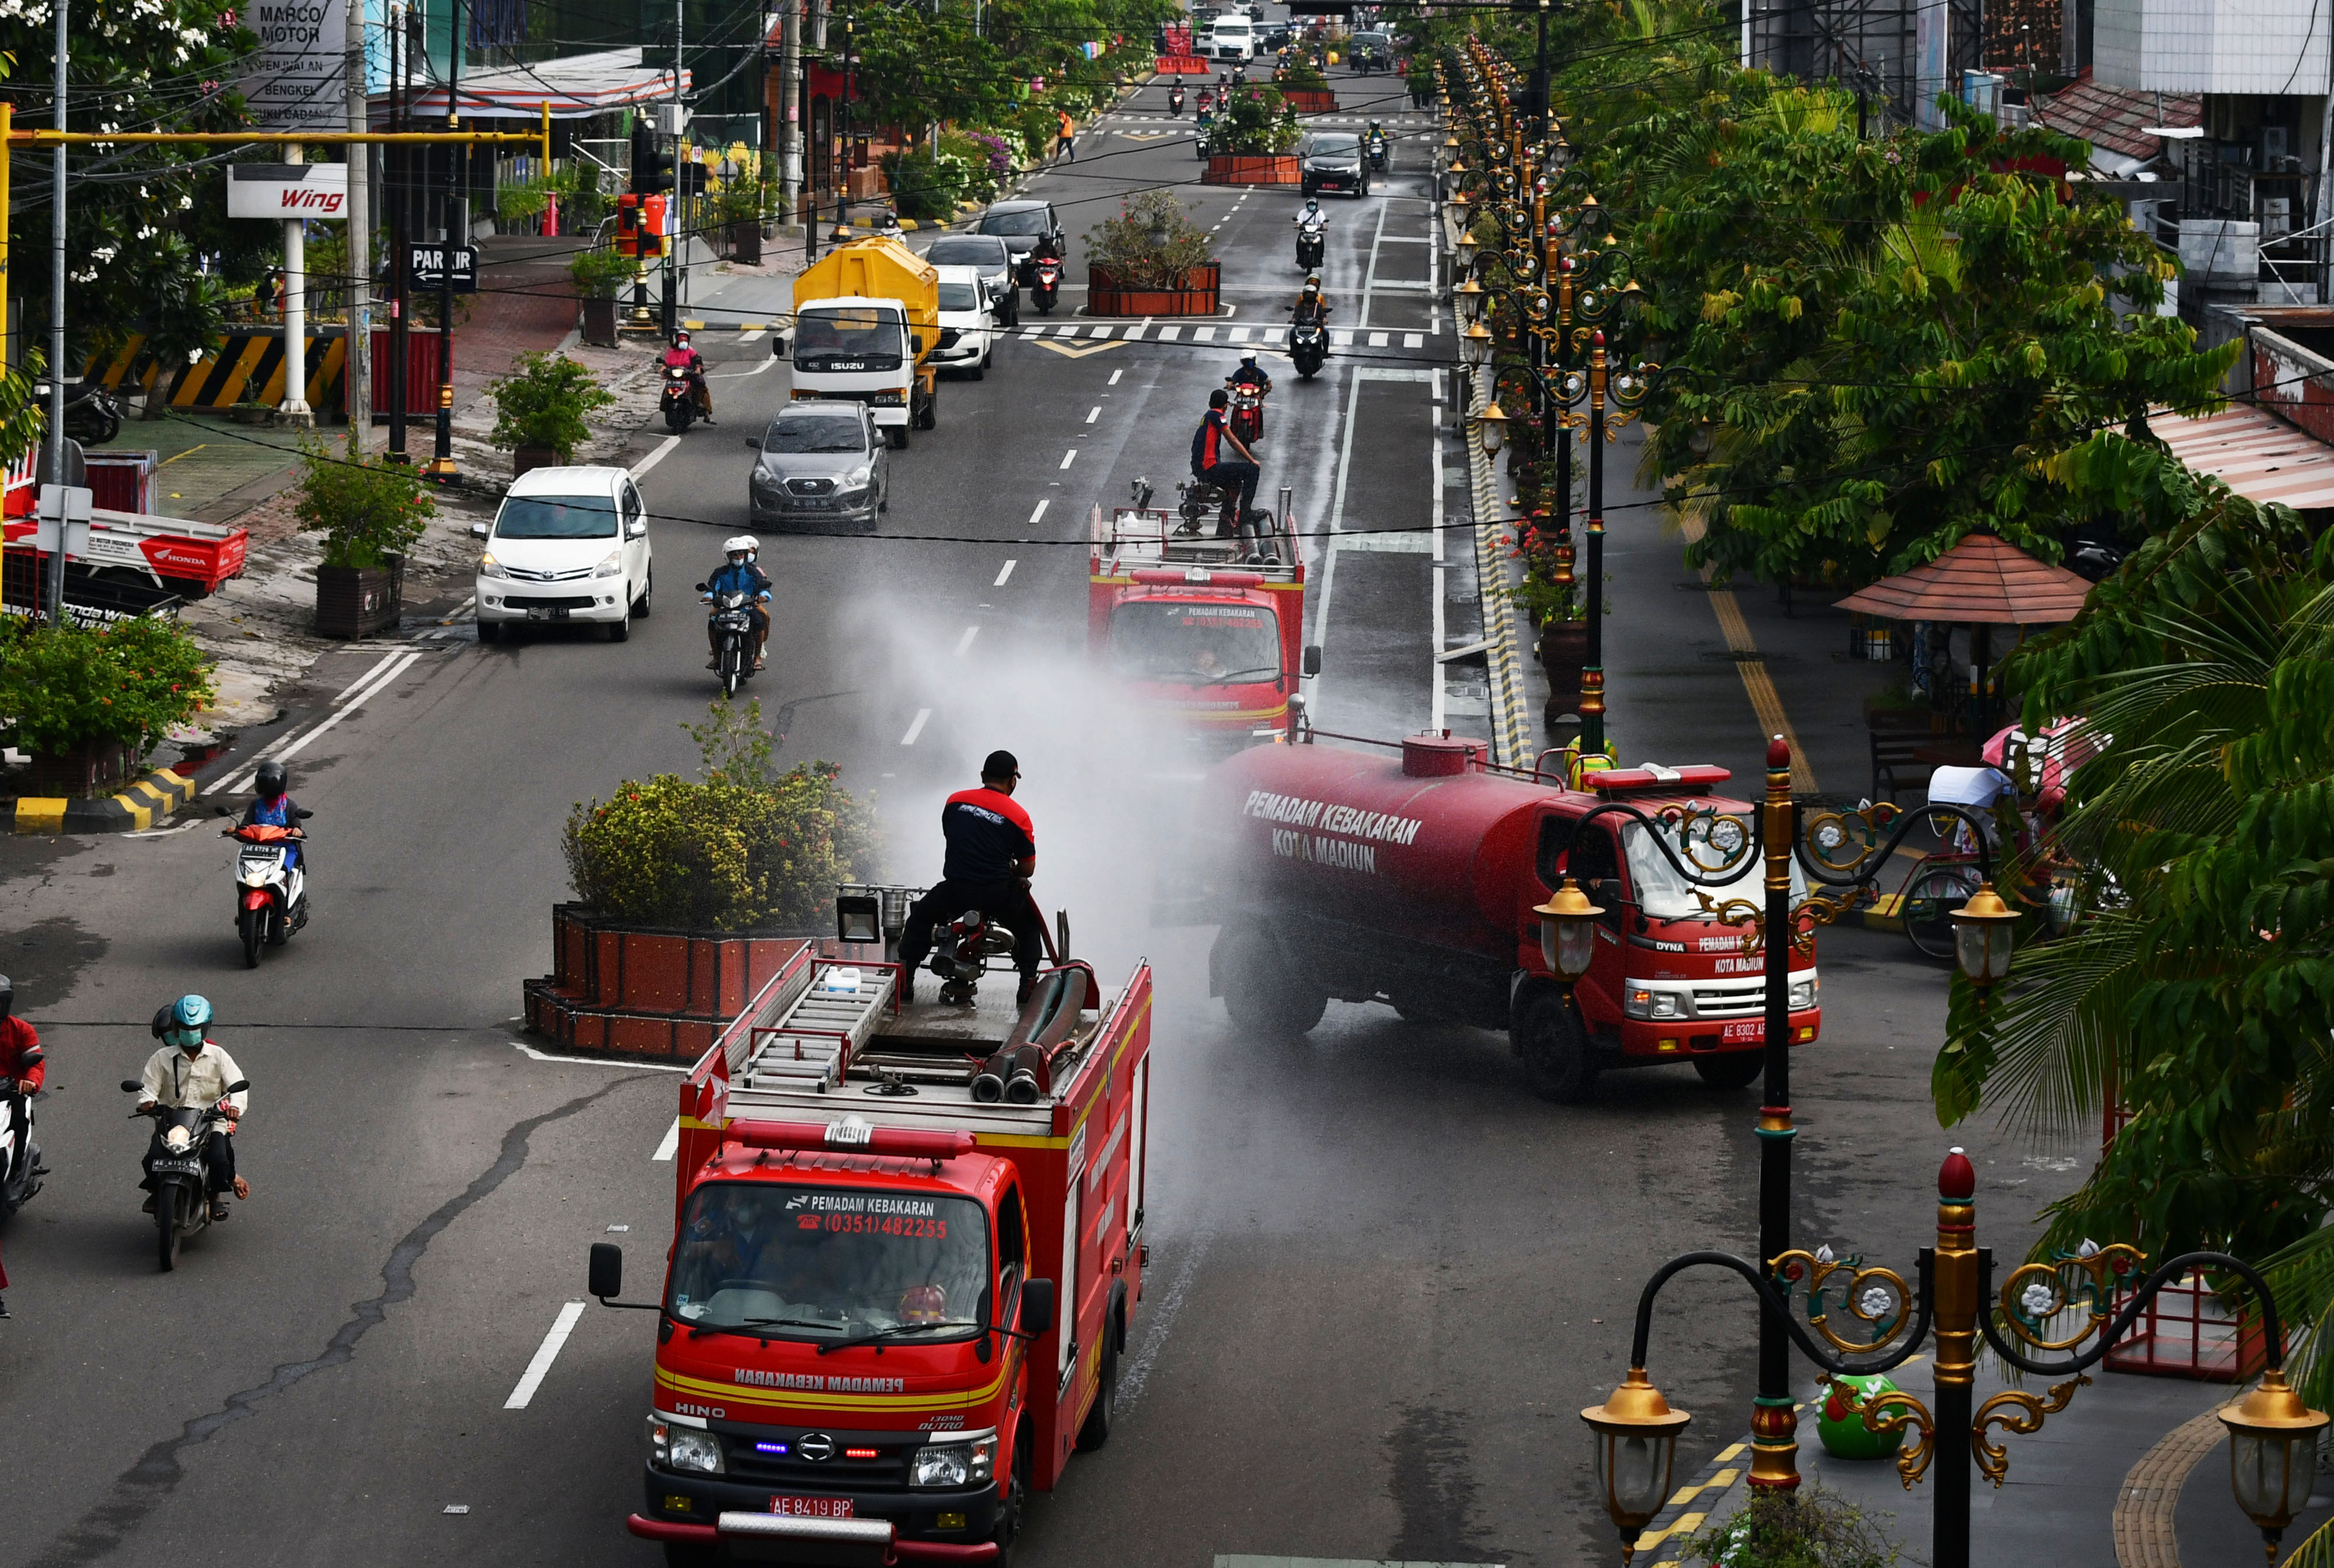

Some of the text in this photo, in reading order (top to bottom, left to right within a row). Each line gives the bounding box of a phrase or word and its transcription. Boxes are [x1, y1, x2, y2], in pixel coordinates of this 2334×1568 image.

[260, 6, 321, 22] MARCO
[261, 27, 320, 43] MOTOR
[265, 85, 316, 96] BENGKEL
[281, 190, 344, 212] Wing
[168, 555, 207, 566] HONDA
[61, 602, 103, 618] onda
[1218, 608, 1255, 618] KEBAKARAN
[1243, 790, 1422, 845] PEMADAM KEBAKARAN
[1272, 828, 1375, 874] KOTA MADIUN
[1656, 942, 1684, 952] DYNA
[1699, 936, 1735, 951] PEMADAM
[1715, 957, 1764, 974] KOTA MADIUN
[1724, 1025, 1733, 1037] AE
[1736, 1024, 1755, 1036] 8302
[812, 1196, 934, 1216] PEMADAM KEBAKARAN
[676, 1402, 725, 1418] HINO
[918, 1422, 965, 1430] DUTRO
[774, 1498, 850, 1517] AE 8419 BP
